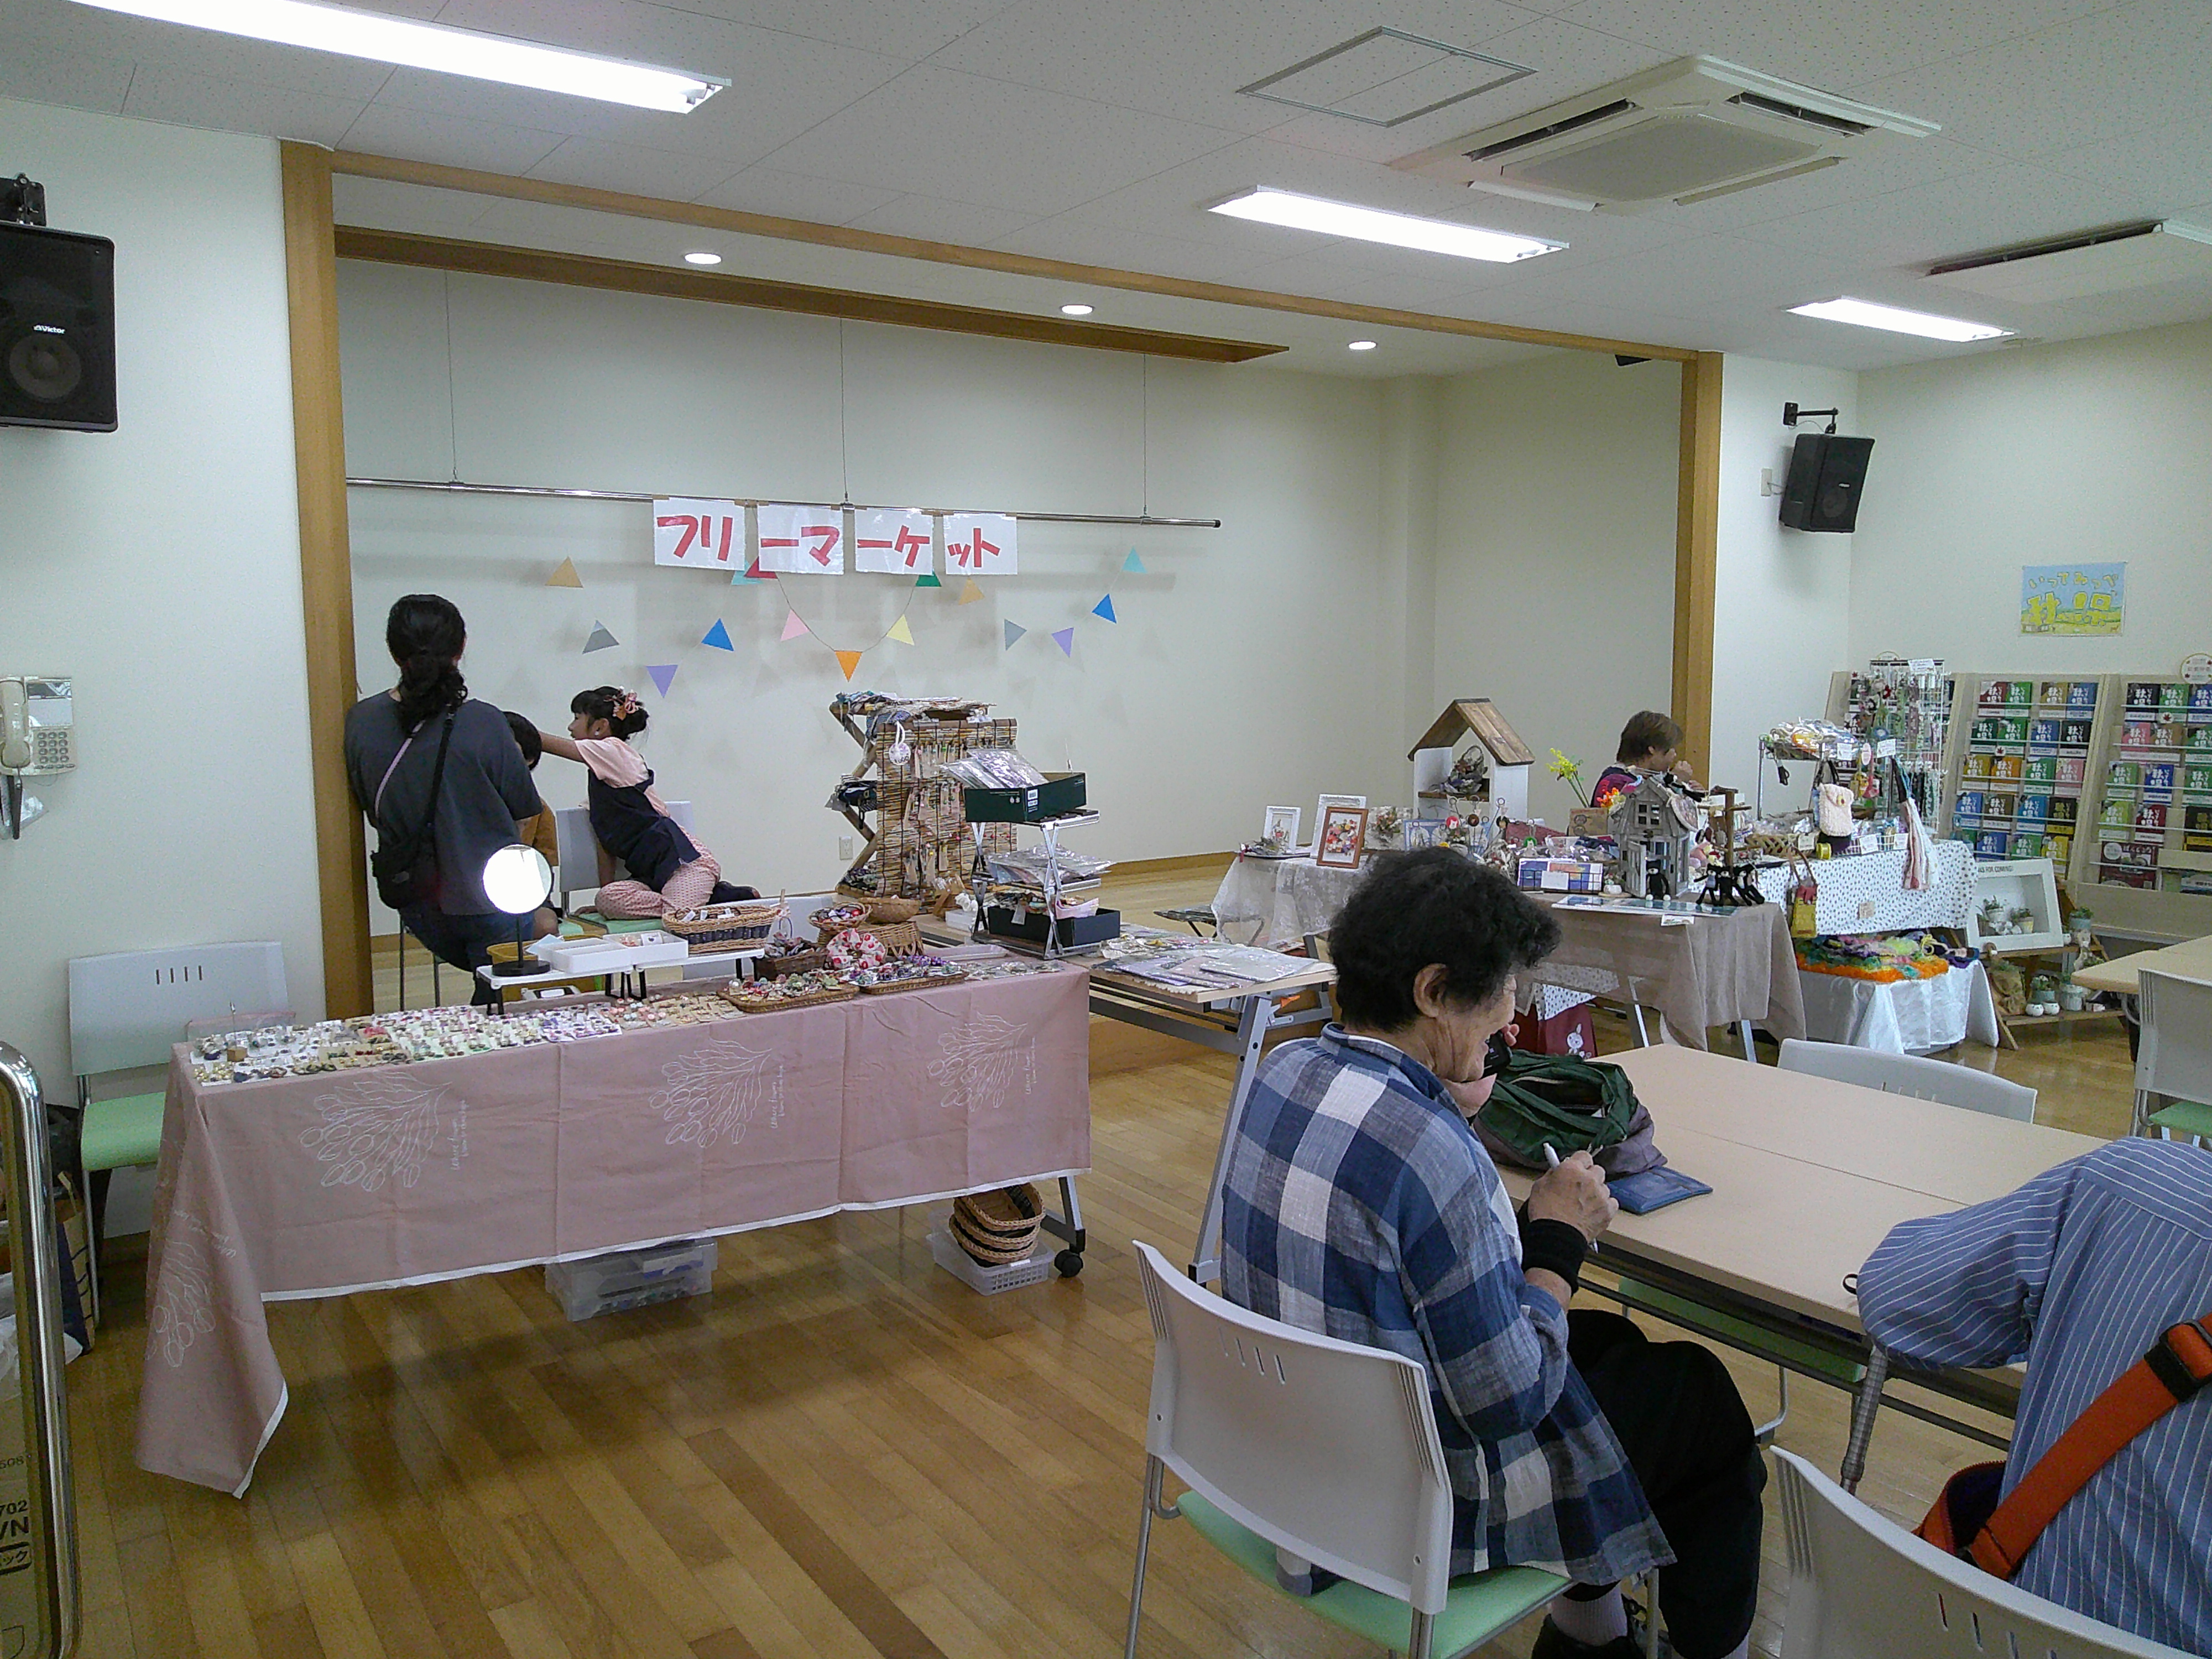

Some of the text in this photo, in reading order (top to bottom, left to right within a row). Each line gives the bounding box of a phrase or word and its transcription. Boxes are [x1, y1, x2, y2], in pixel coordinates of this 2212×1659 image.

[41, 325, 65, 334] Victor
[656, 515, 1001, 568] フリーマーケット
[0, 1551, 28, 1566] ック
